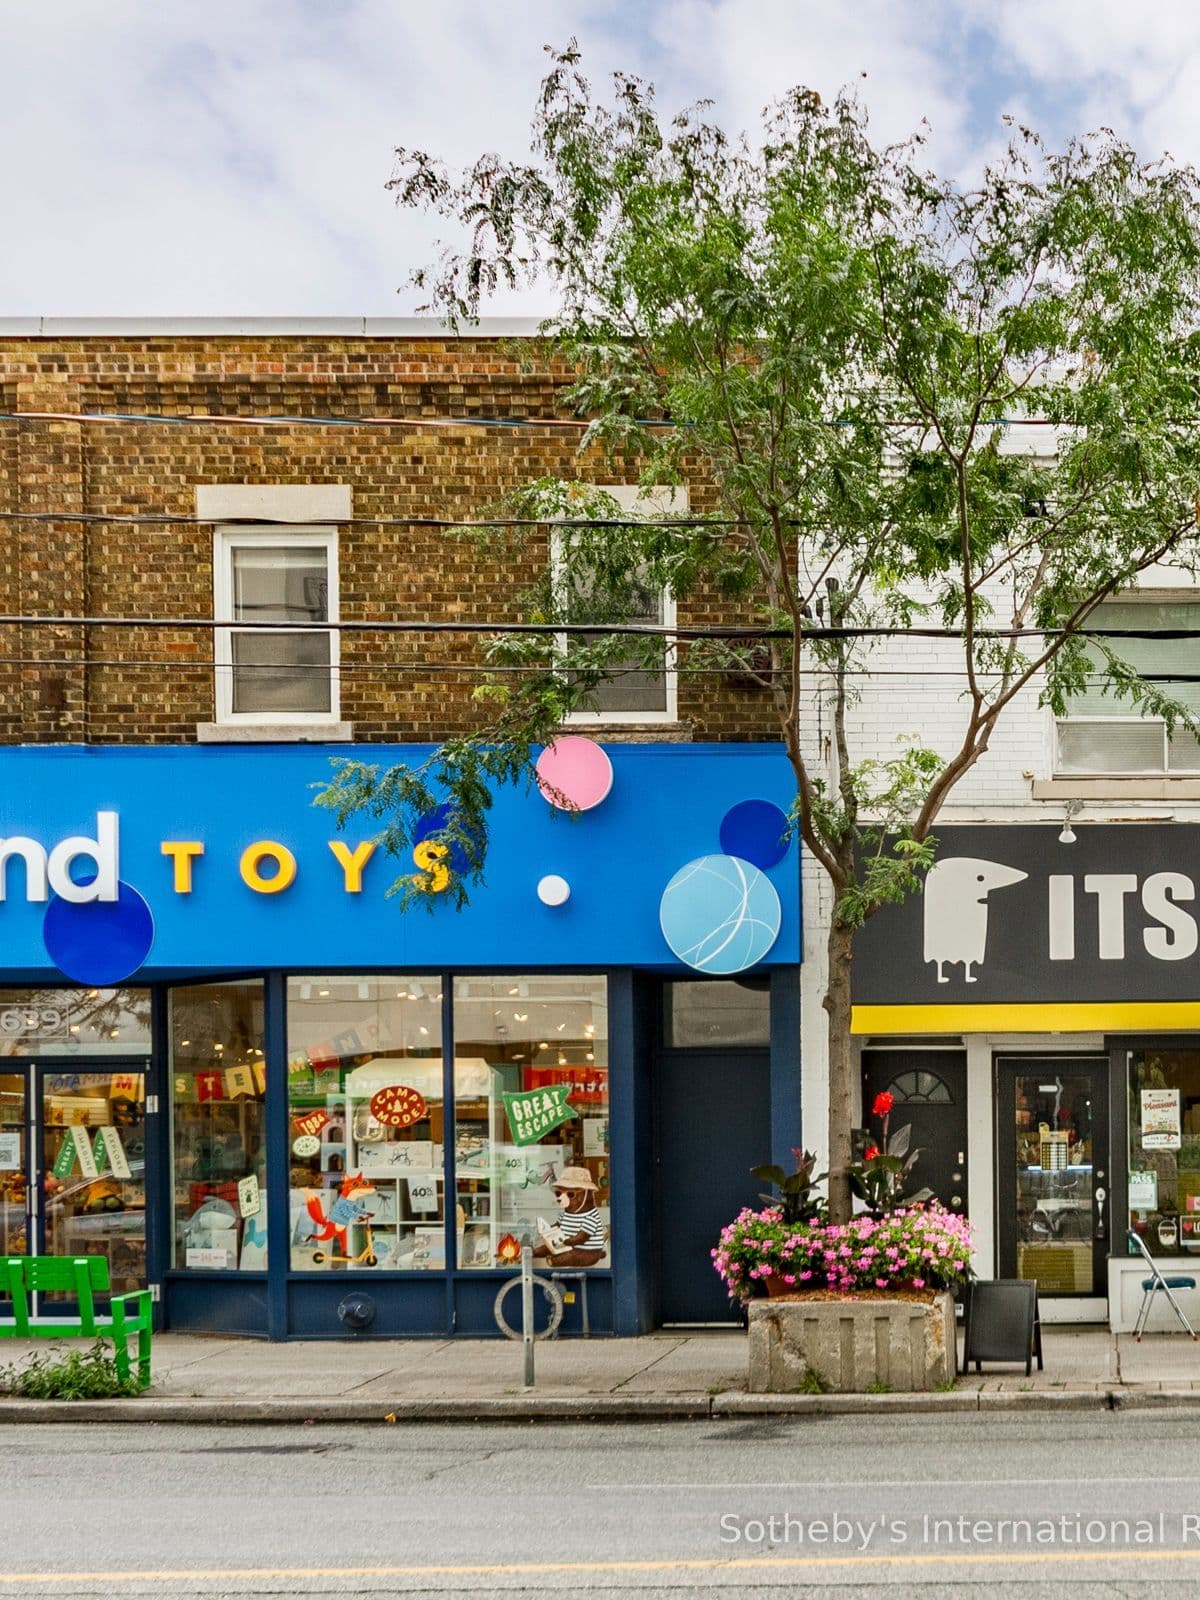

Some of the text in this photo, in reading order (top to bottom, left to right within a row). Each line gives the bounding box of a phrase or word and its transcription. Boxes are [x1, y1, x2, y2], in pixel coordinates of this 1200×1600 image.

[160, 839, 450, 894] TOYS
[1049, 872, 1198, 960] ITS
[376, 1088, 418, 1104] CAMP
[511, 1091, 560, 1121] GREAT
[377, 1109, 420, 1125] MODE
[517, 1106, 564, 1139] ESCAPE
[60, 1141, 74, 1172] CREATE
[94, 1139, 105, 1161] PLAY
